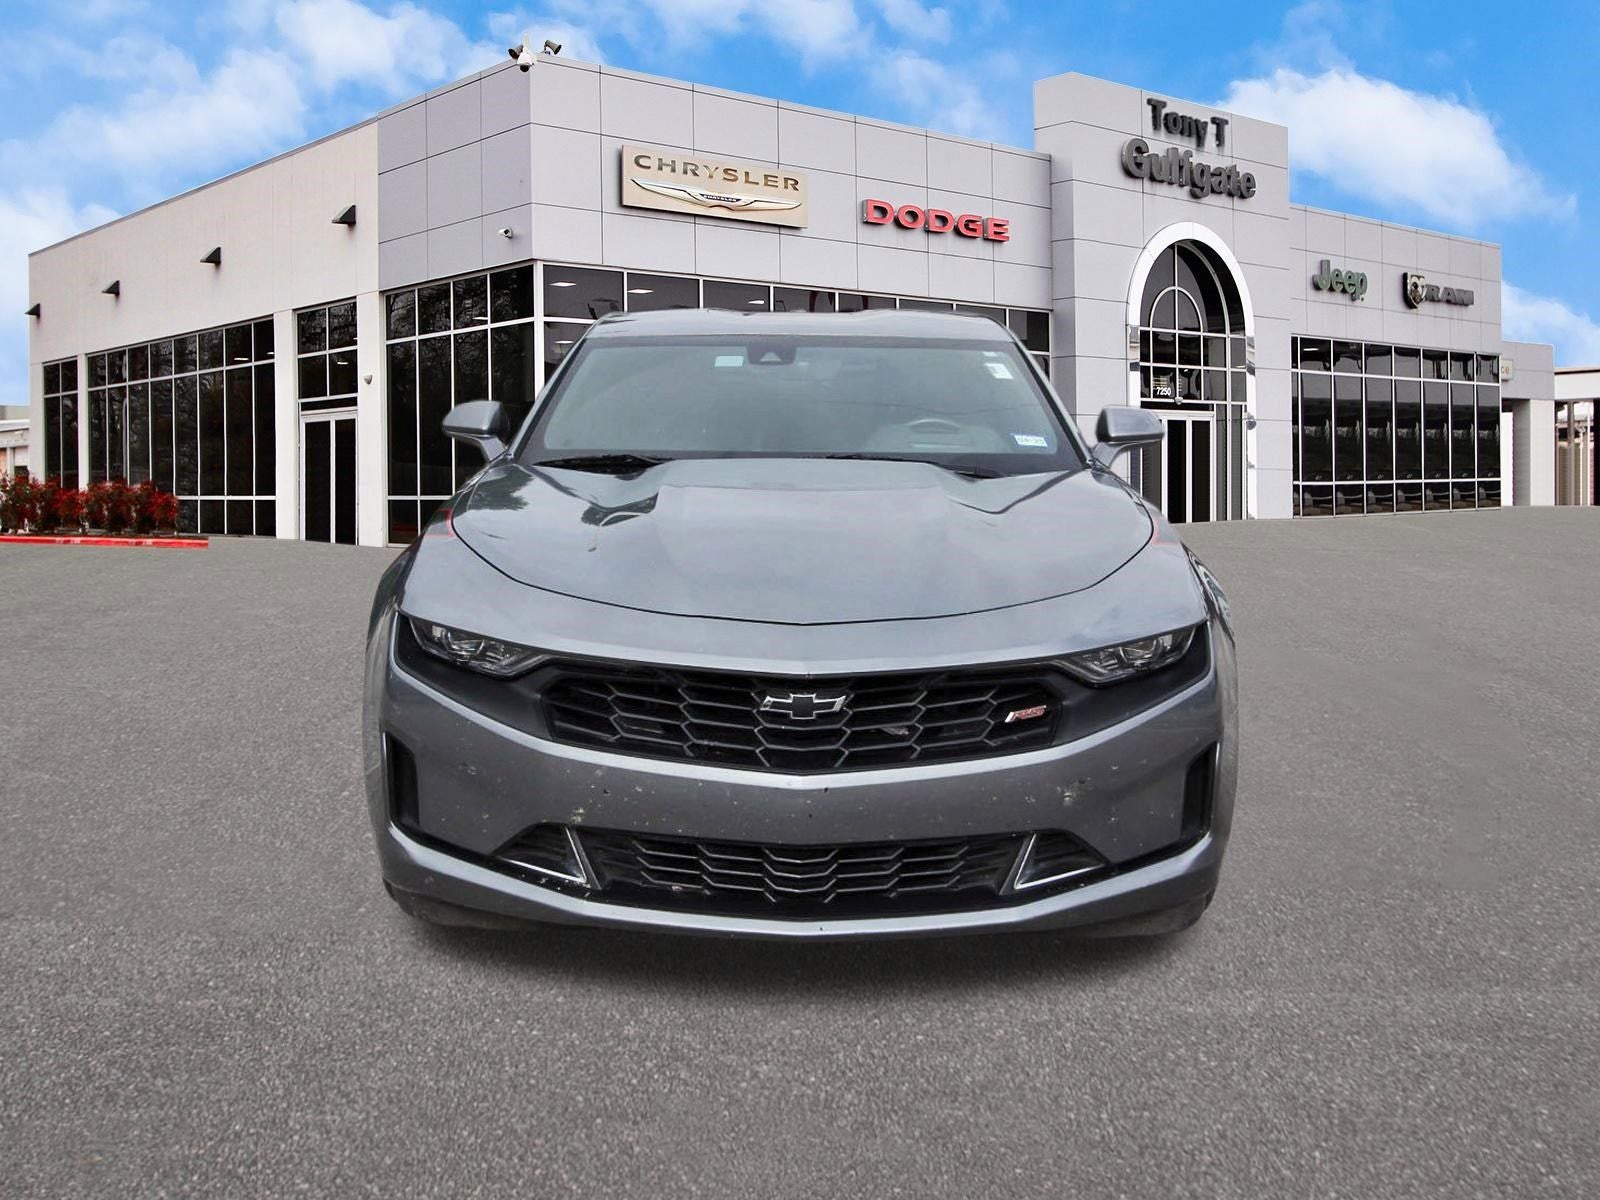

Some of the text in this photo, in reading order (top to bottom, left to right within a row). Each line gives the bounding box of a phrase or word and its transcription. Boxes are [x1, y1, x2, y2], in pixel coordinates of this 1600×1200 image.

[1147, 98, 1229, 147] Tony T
[633, 153, 801, 192] CHRYSLER
[1121, 138, 1257, 199] Gulfgate
[862, 198, 1010, 242] DODGE
[1313, 259, 1368, 301] Jeep
[1424, 284, 1475, 306] RAM
[1156, 386, 1172, 396] 7250
